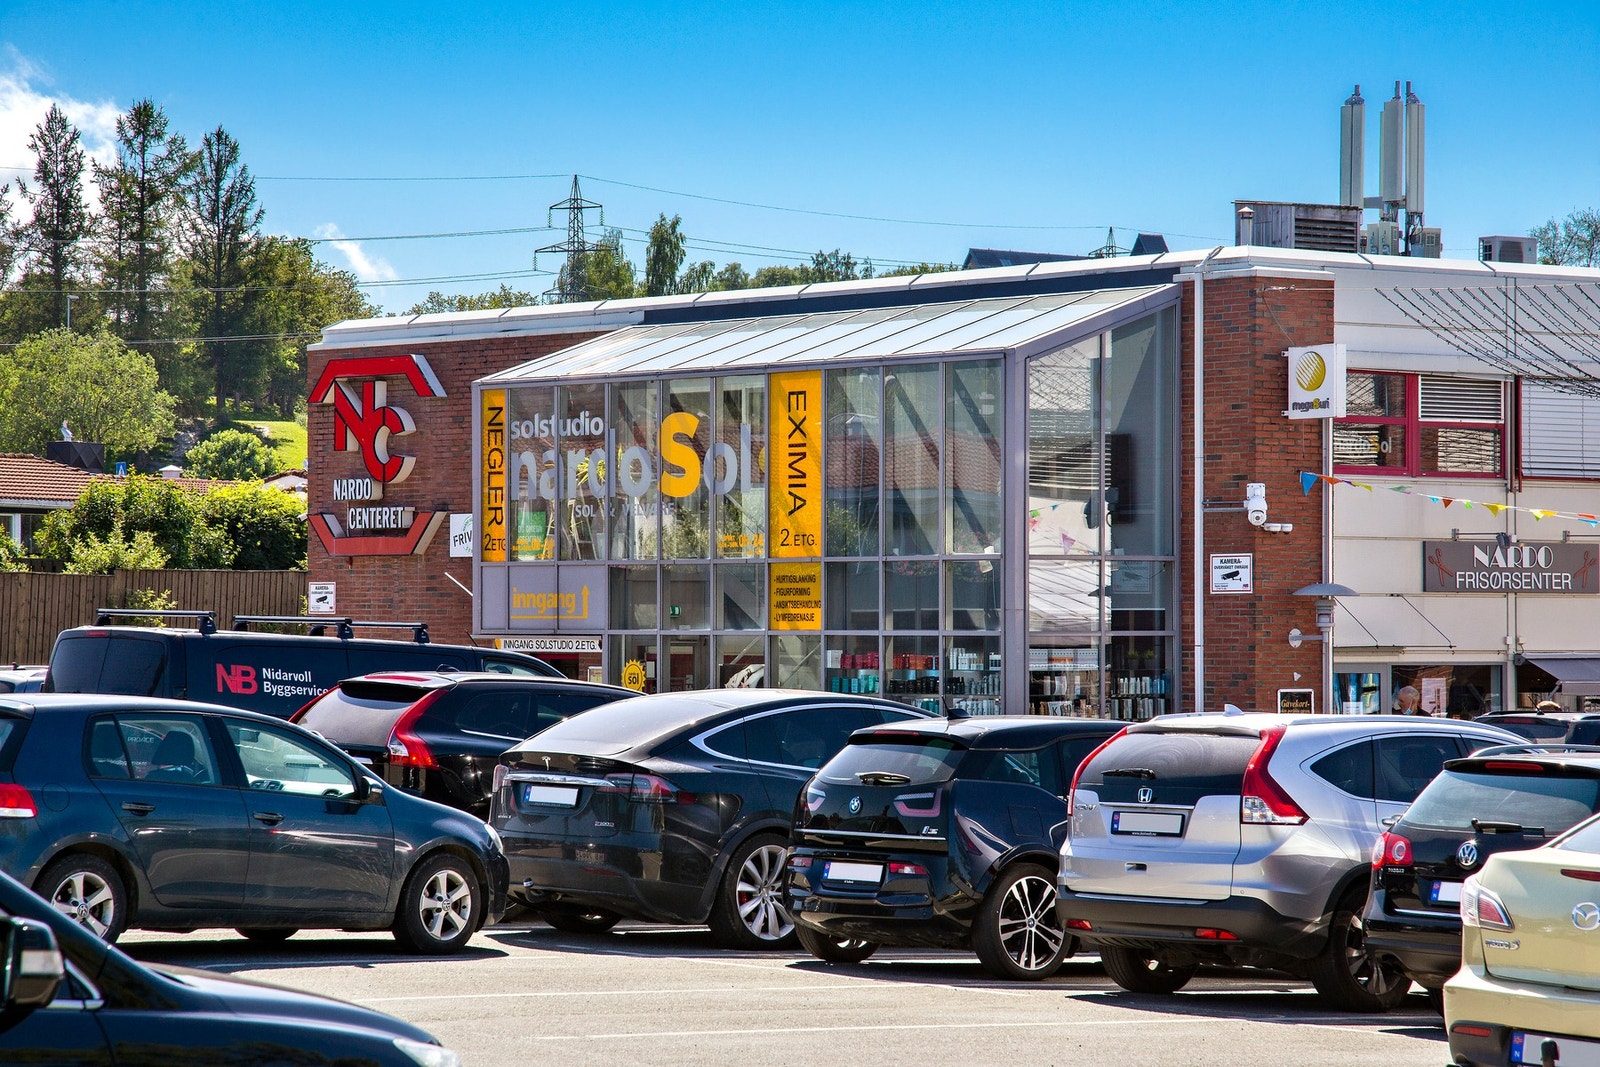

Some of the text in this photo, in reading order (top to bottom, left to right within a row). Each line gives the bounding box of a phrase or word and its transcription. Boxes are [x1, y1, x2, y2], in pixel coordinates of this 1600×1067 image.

[510, 410, 604, 439] solstudio
[788, 390, 807, 517] EXIMIA
[487, 406, 504, 527] NEGLER
[333, 478, 371, 500] NARDO
[349, 507, 403, 529] CENTERET
[575, 504, 596, 518] SOL
[1473, 544, 1553, 568] NARDO
[1456, 571, 1572, 589] FRISØRSENTER
[512, 586, 576, 615] inngang
[503, 640, 534, 650] INNGANG
[535, 640, 574, 650] SOLSTUDIO
[216, 663, 258, 695] NB
[262, 668, 312, 682] Nidarvoll
